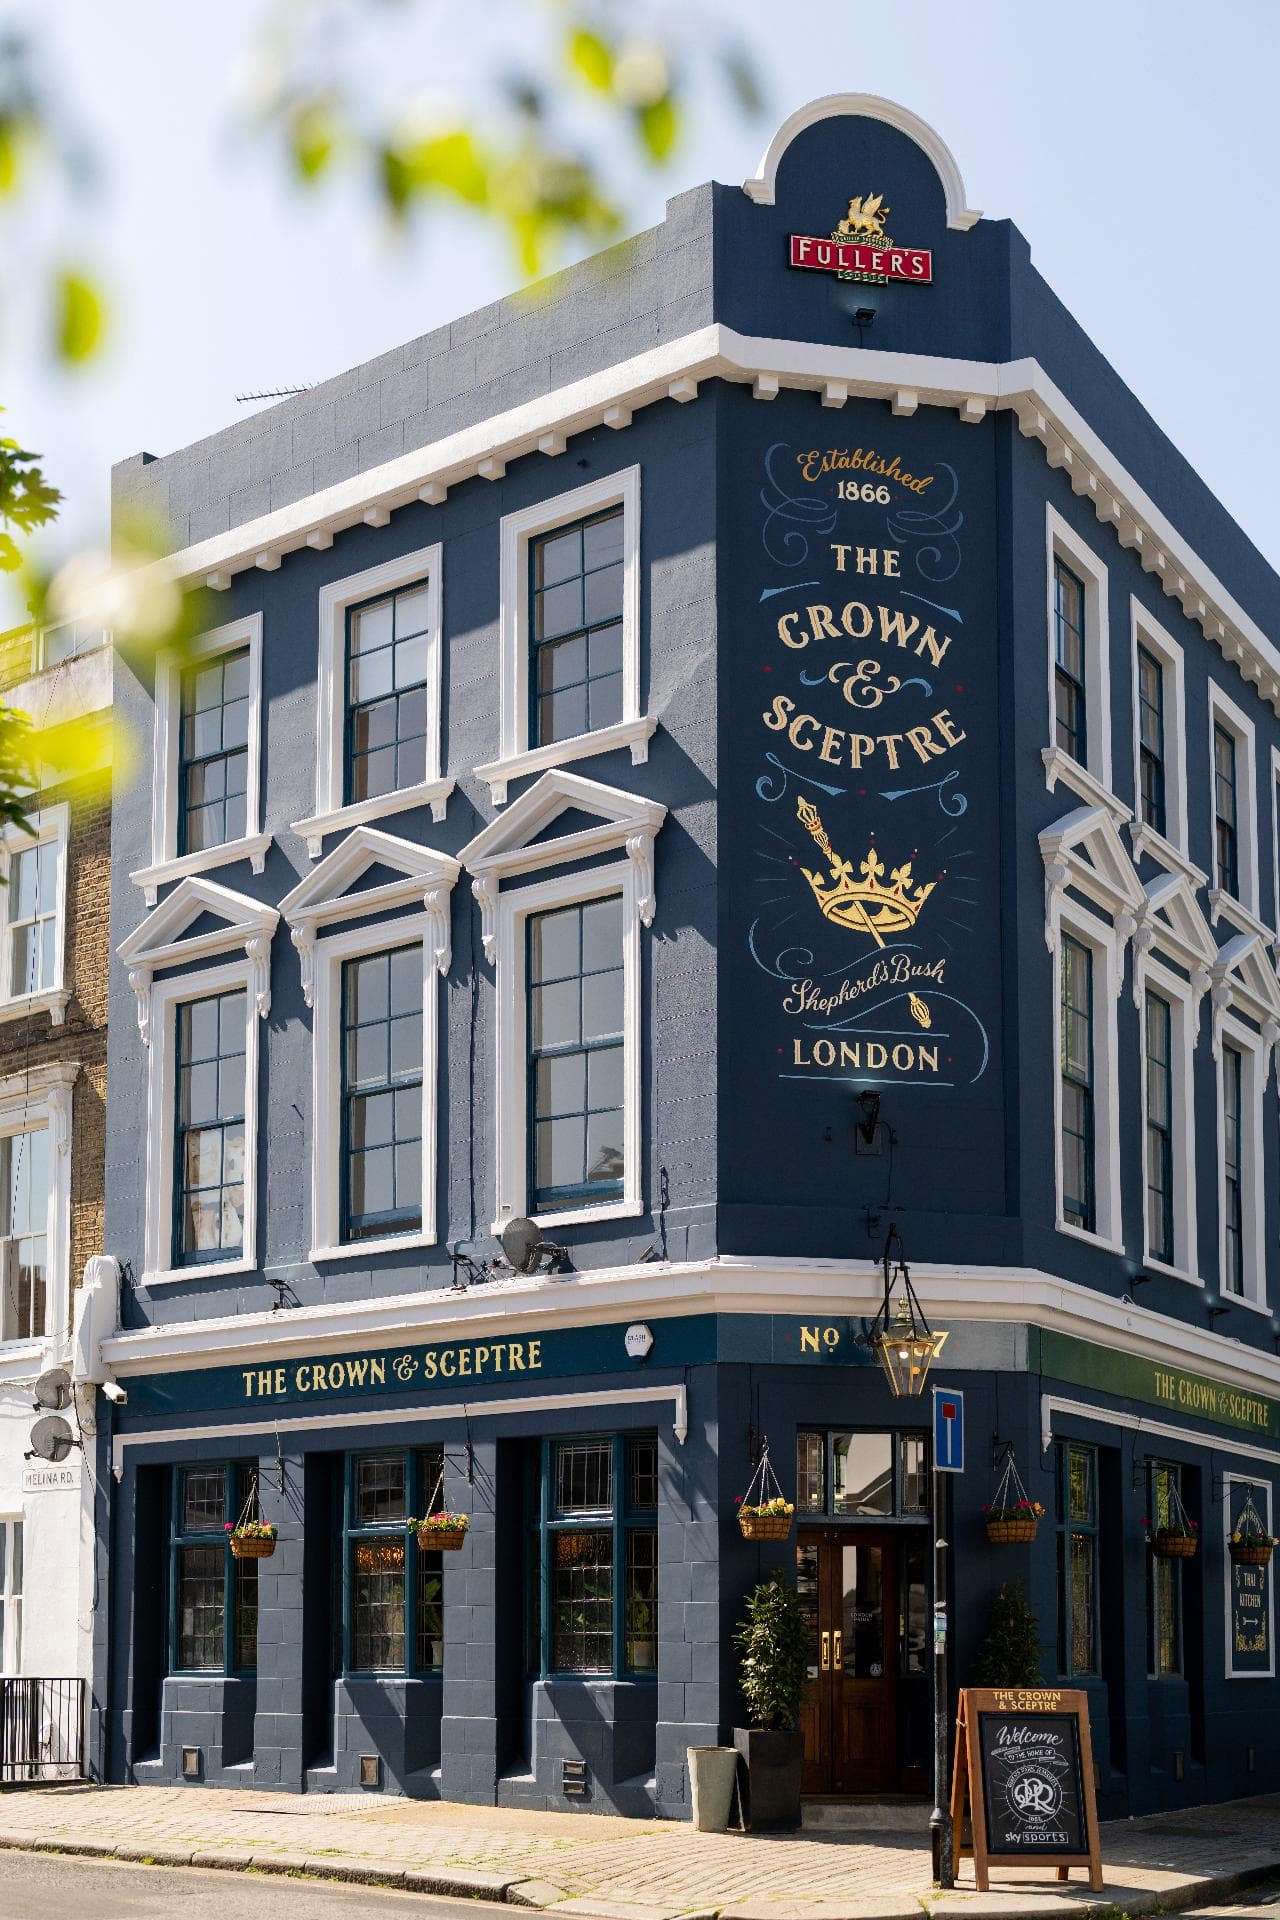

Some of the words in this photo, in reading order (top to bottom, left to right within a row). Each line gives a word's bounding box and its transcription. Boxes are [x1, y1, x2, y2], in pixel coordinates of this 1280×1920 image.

[799, 240, 924, 276] FULLER'S
[796, 448, 934, 495] Established
[838, 480, 891, 504] 1866
[831, 543, 901, 578] THE
[777, 602, 952, 669] CROWN
[828, 659, 901, 709] &
[762, 695, 967, 770] SCEPTRE
[783, 960, 889, 1015] Shepherd's
[890, 953, 947, 984] Bush
[793, 1038, 939, 1072] LONDON
[243, 1368, 287, 1397] THE
[295, 1357, 386, 1392] CROWN
[392, 1355, 418, 1381] &
[424, 1340, 543, 1379] SCEPTRE
[1154, 1372, 1176, 1400] THE
[1178, 1379, 1216, 1413] CROWN
[1218, 1391, 1229, 1414] &
[1229, 1394, 1269, 1427] SCEPTRE
[25, 1472, 59, 1487] MELINA
[1239, 1593, 1261, 1608] KITCHEN
[992, 1691, 1014, 1701] THE
[1018, 1691, 1061, 1701] CROWN
[998, 1701, 1007, 1710] &
[1011, 1701, 1057, 1711] SCEPTRE
[996, 1725, 1063, 1746] Welcome
[1005, 1832, 1022, 1844] sky
[1024, 1832, 1066, 1843] sports
